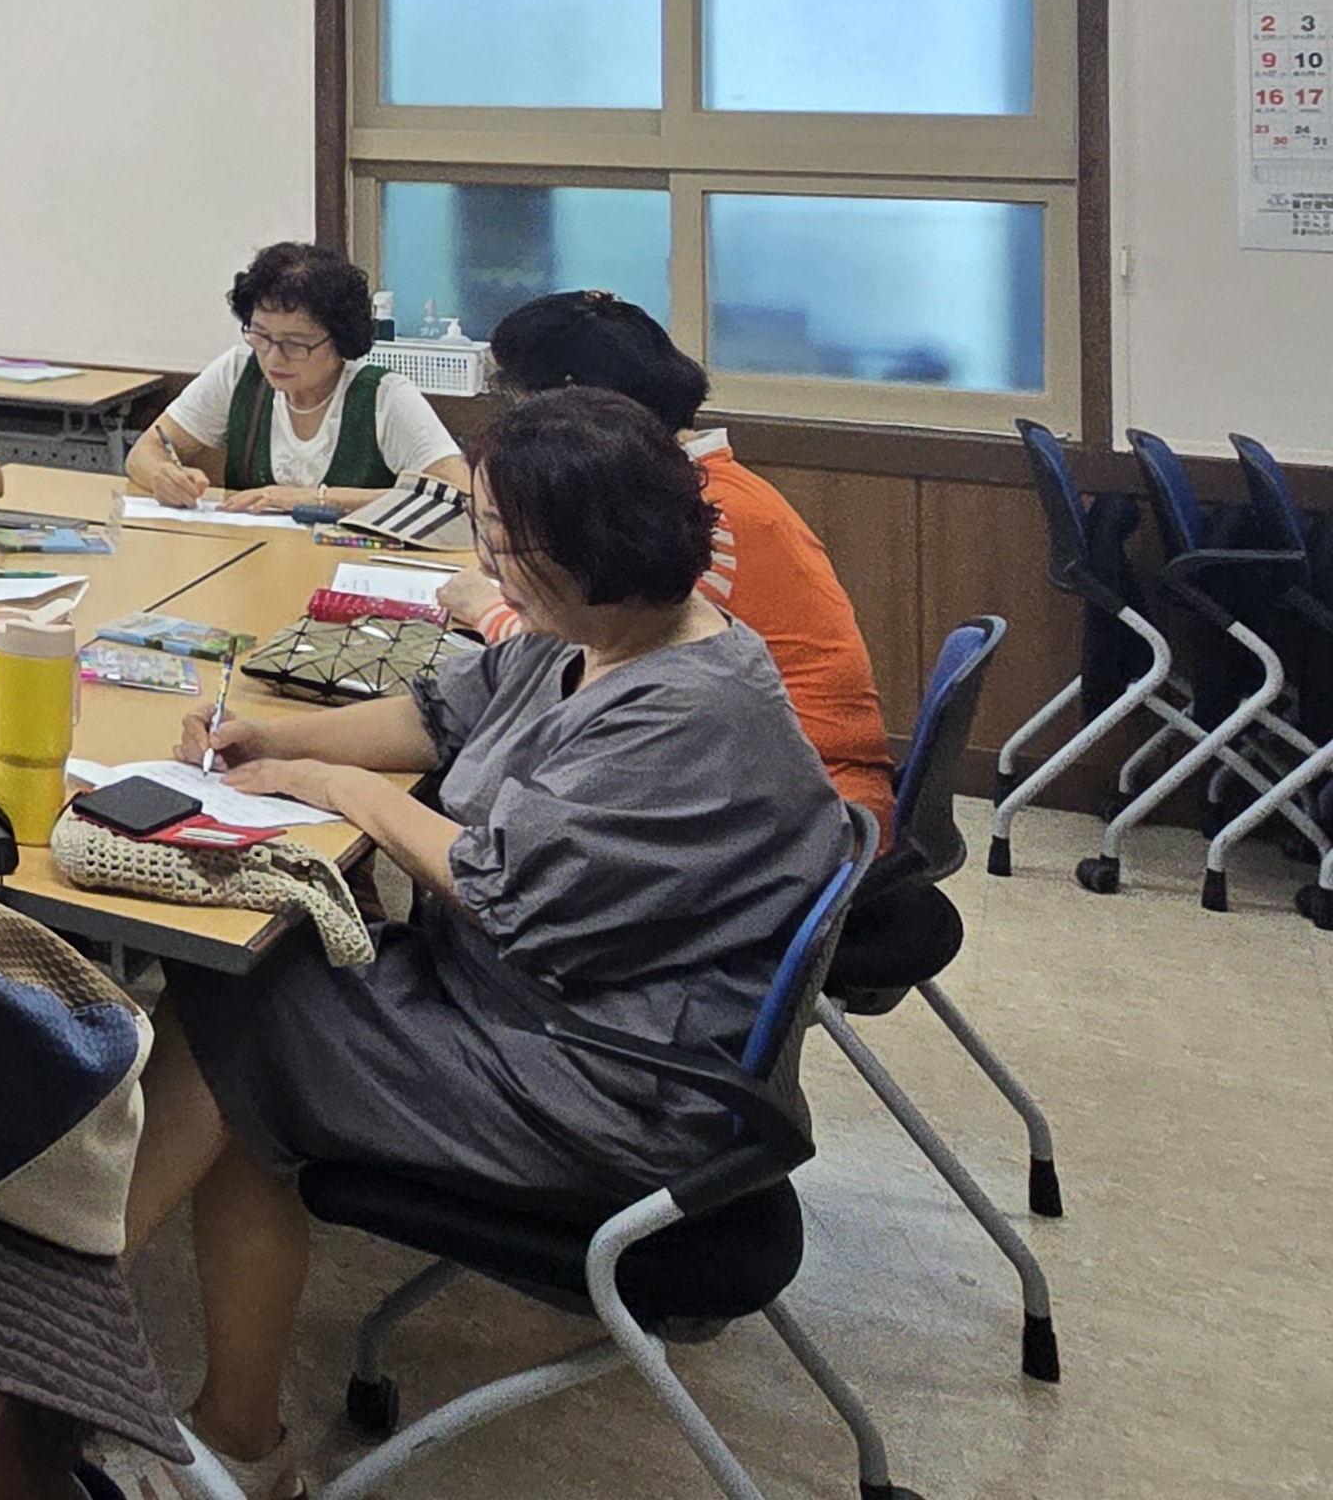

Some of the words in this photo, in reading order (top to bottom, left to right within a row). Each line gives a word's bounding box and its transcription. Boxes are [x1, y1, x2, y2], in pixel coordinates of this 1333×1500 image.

[1260, 14, 1276, 32] 2
[1300, 14, 1316, 32] 3
[1261, 52, 1277, 68] 9
[1294, 52, 1323, 69] 10
[1255, 88, 1284, 105] 16
[1294, 88, 1324, 105] 17
